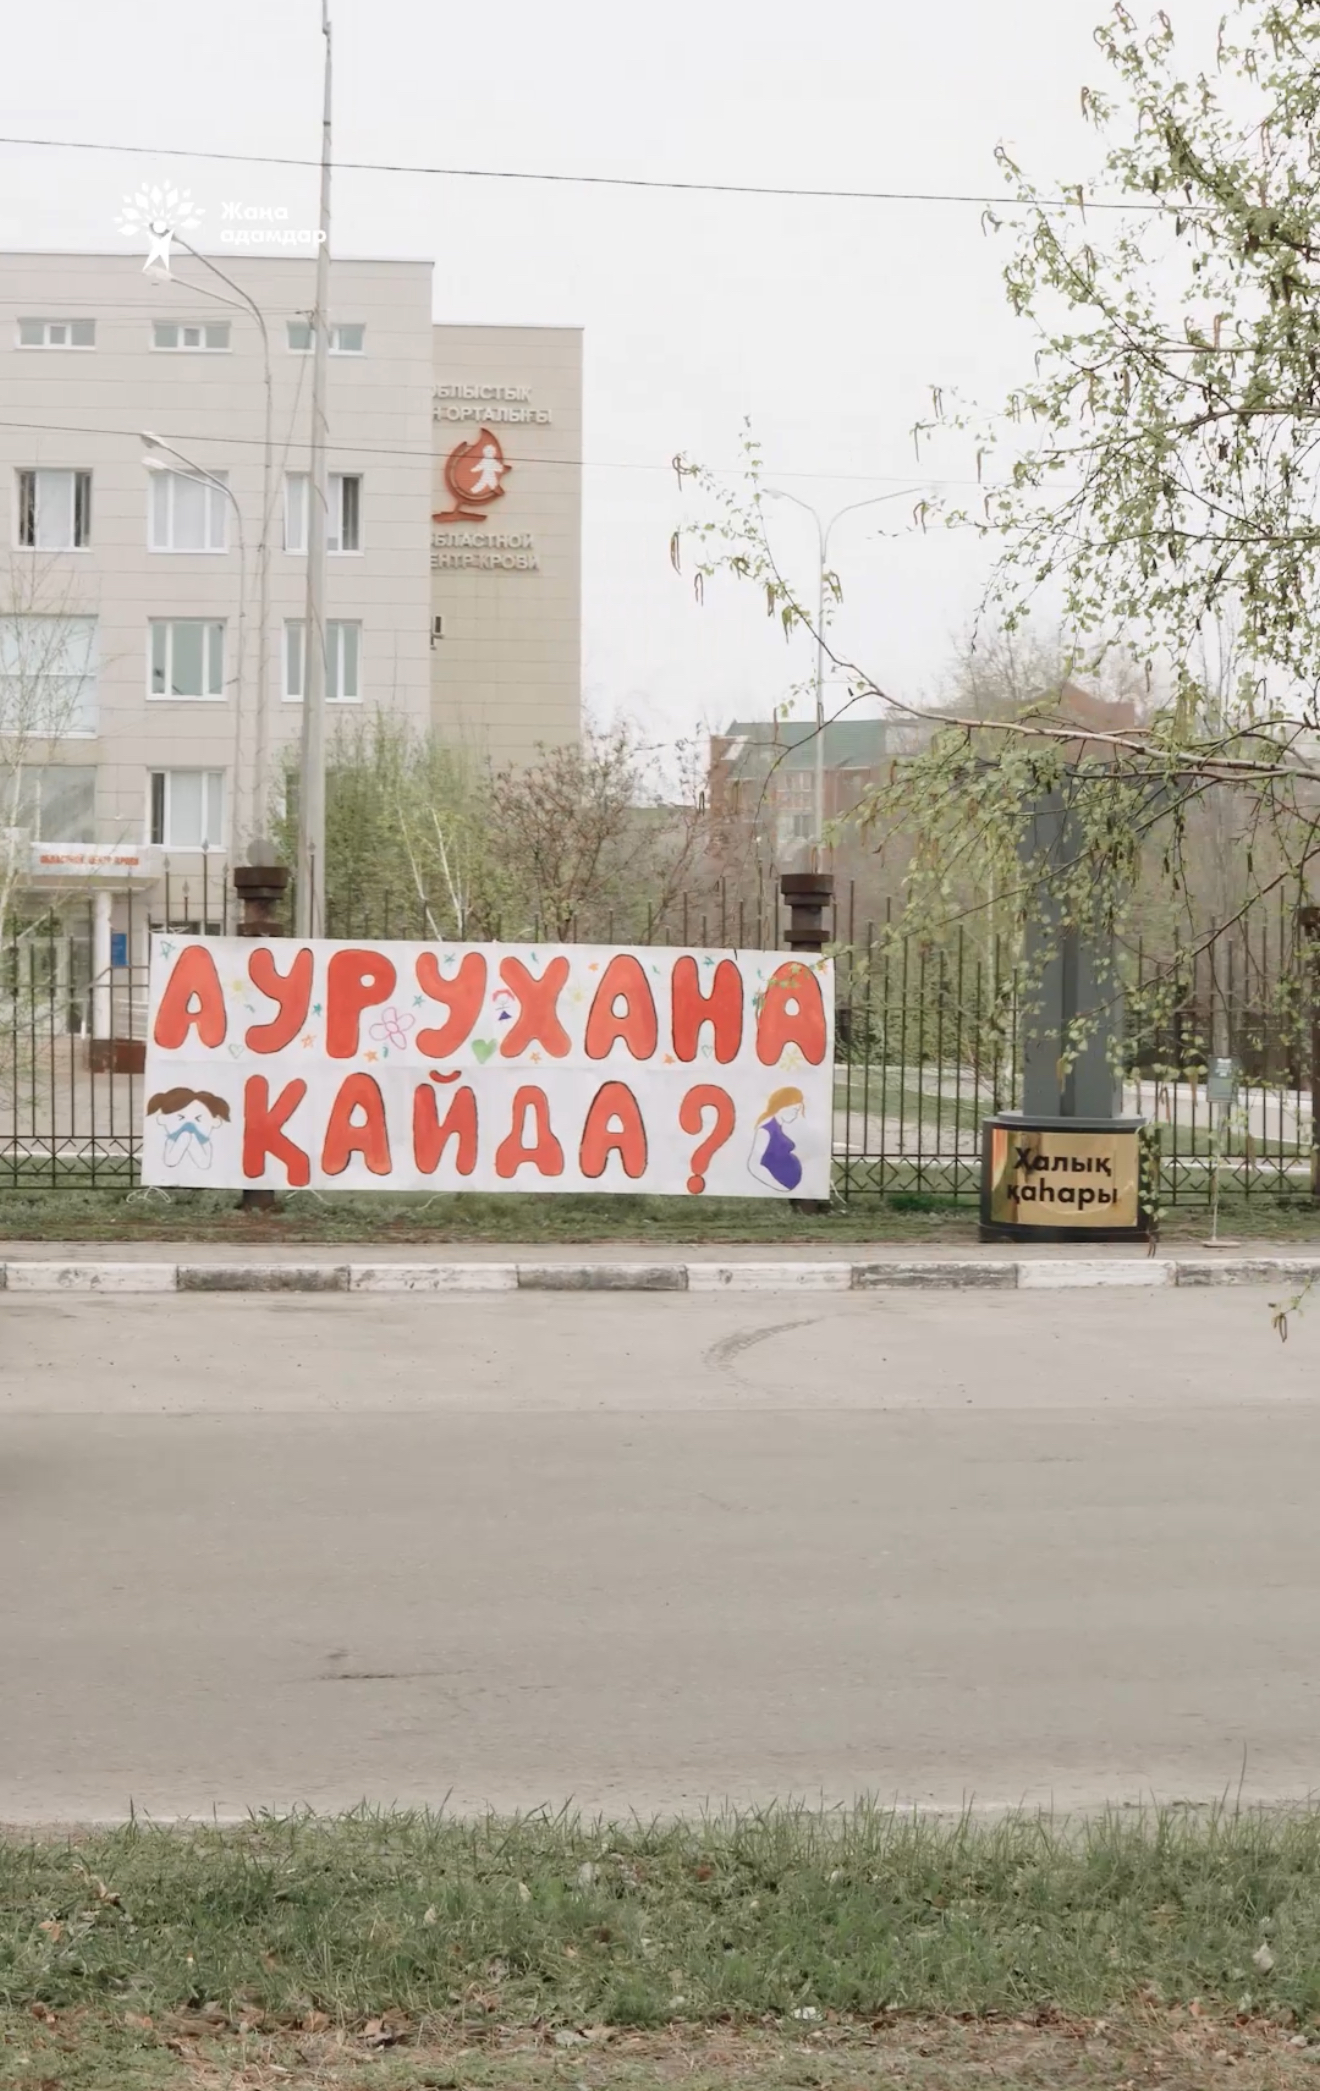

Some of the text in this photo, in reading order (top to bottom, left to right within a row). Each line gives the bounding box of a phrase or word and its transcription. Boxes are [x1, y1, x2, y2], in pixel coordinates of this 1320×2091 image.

[431, 531, 534, 549] БЛАСТНОЙ
[154, 945, 827, 1066] АУРУХАНА
[1014, 1147, 1112, 1177] Халық
